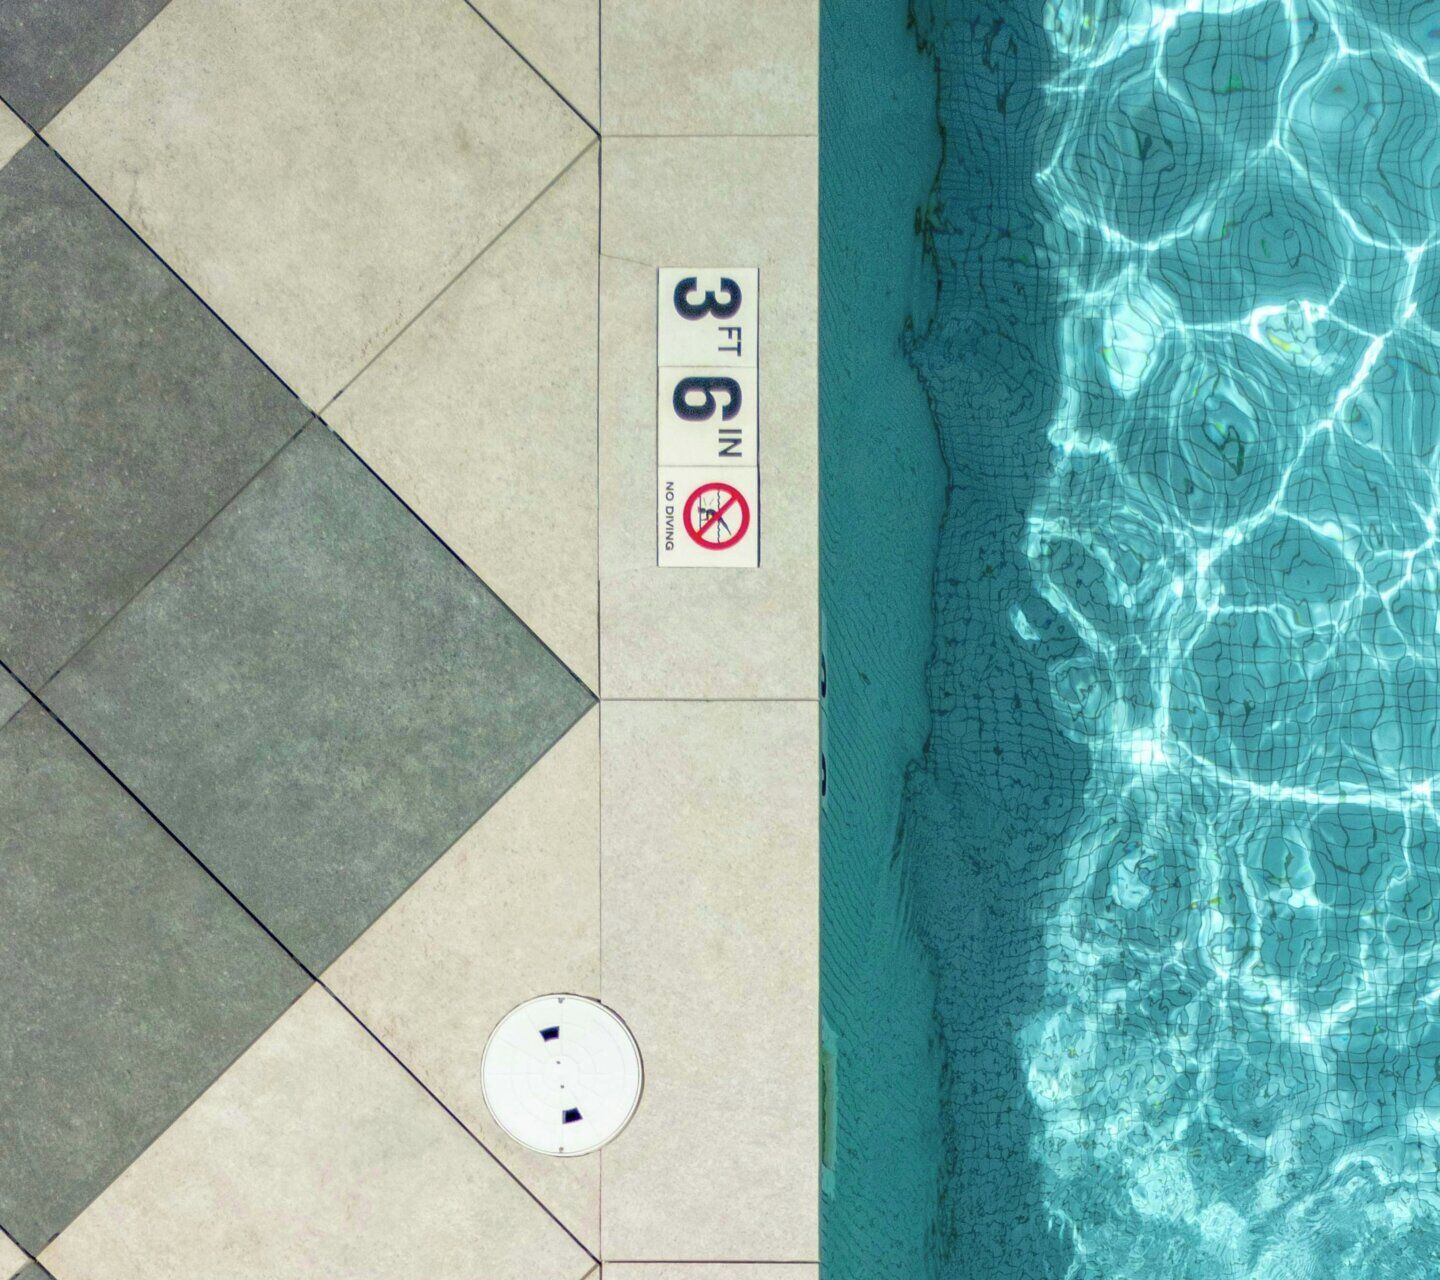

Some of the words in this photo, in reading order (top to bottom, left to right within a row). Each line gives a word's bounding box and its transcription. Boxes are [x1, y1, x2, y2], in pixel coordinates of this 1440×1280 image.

[673, 276, 742, 321] 3
[718, 326, 742, 357] FT
[672, 376, 742, 422] 6
[718, 428, 742, 457] IN
[665, 481, 674, 501] NO
[665, 506, 674, 551] DIVING
